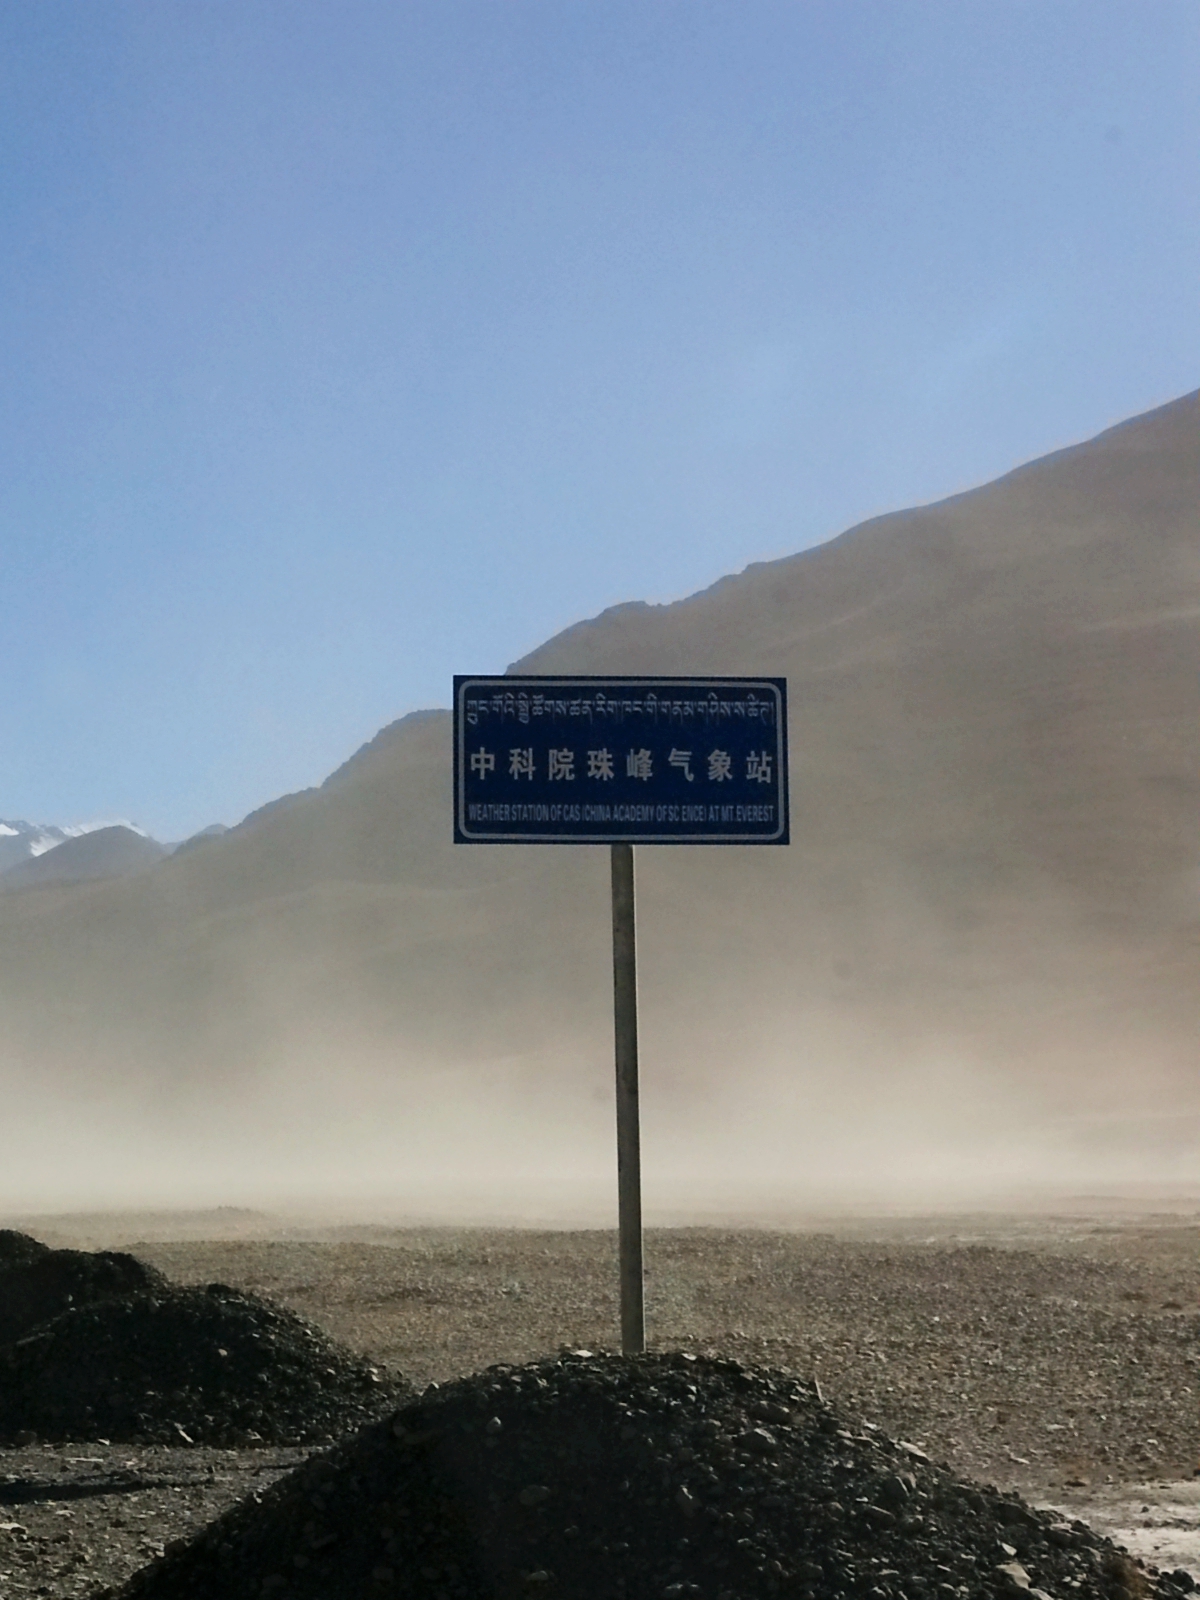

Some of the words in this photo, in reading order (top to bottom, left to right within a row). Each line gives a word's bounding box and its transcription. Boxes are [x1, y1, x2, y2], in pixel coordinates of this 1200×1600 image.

[470, 747, 773, 783] 中科院珠峰气象站
[468, 804, 510, 821] WEATHER
[511, 804, 549, 821] STATION
[550, 804, 562, 821] OF
[563, 804, 581, 821] CAS
[612, 804, 655, 821] ACADEMY
[656, 805, 668, 821] OF
[708, 805, 720, 821] AT
